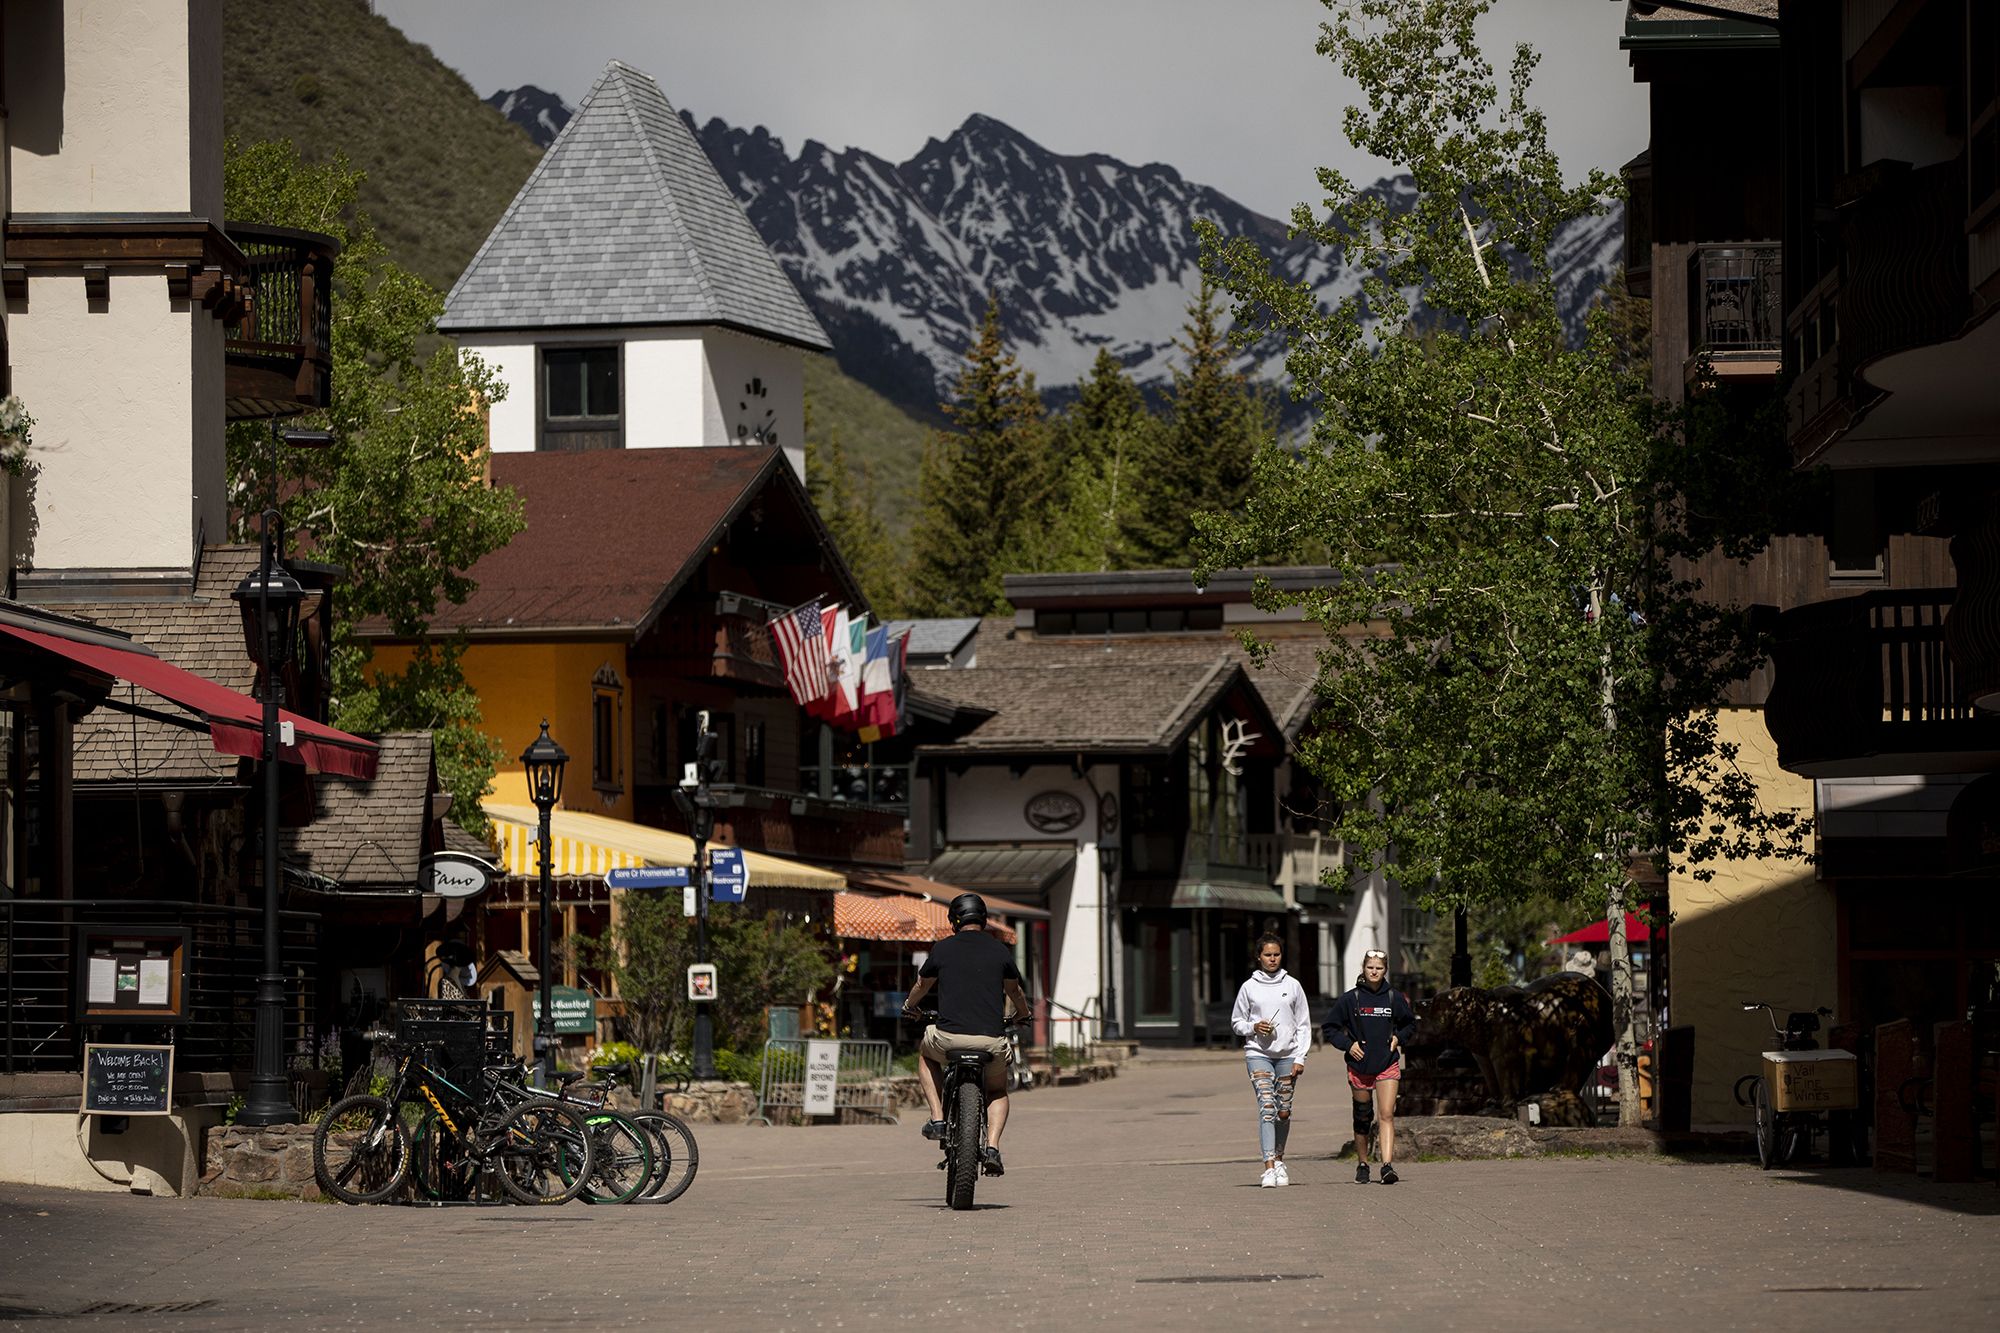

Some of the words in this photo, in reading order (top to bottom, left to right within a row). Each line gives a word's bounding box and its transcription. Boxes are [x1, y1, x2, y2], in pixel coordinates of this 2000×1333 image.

[614, 869, 631, 878] Gore
[631, 868, 639, 878] Cr
[640, 868, 676, 877] Promenade
[97, 1051, 132, 1067] WELCOME
[133, 1053, 164, 1068] BACK!
[810, 1063, 836, 1071] ALCOHOL
[1793, 1063, 1815, 1077] Vail
[106, 1072, 115, 1080] WE
[811, 1073, 834, 1081] BEYOND
